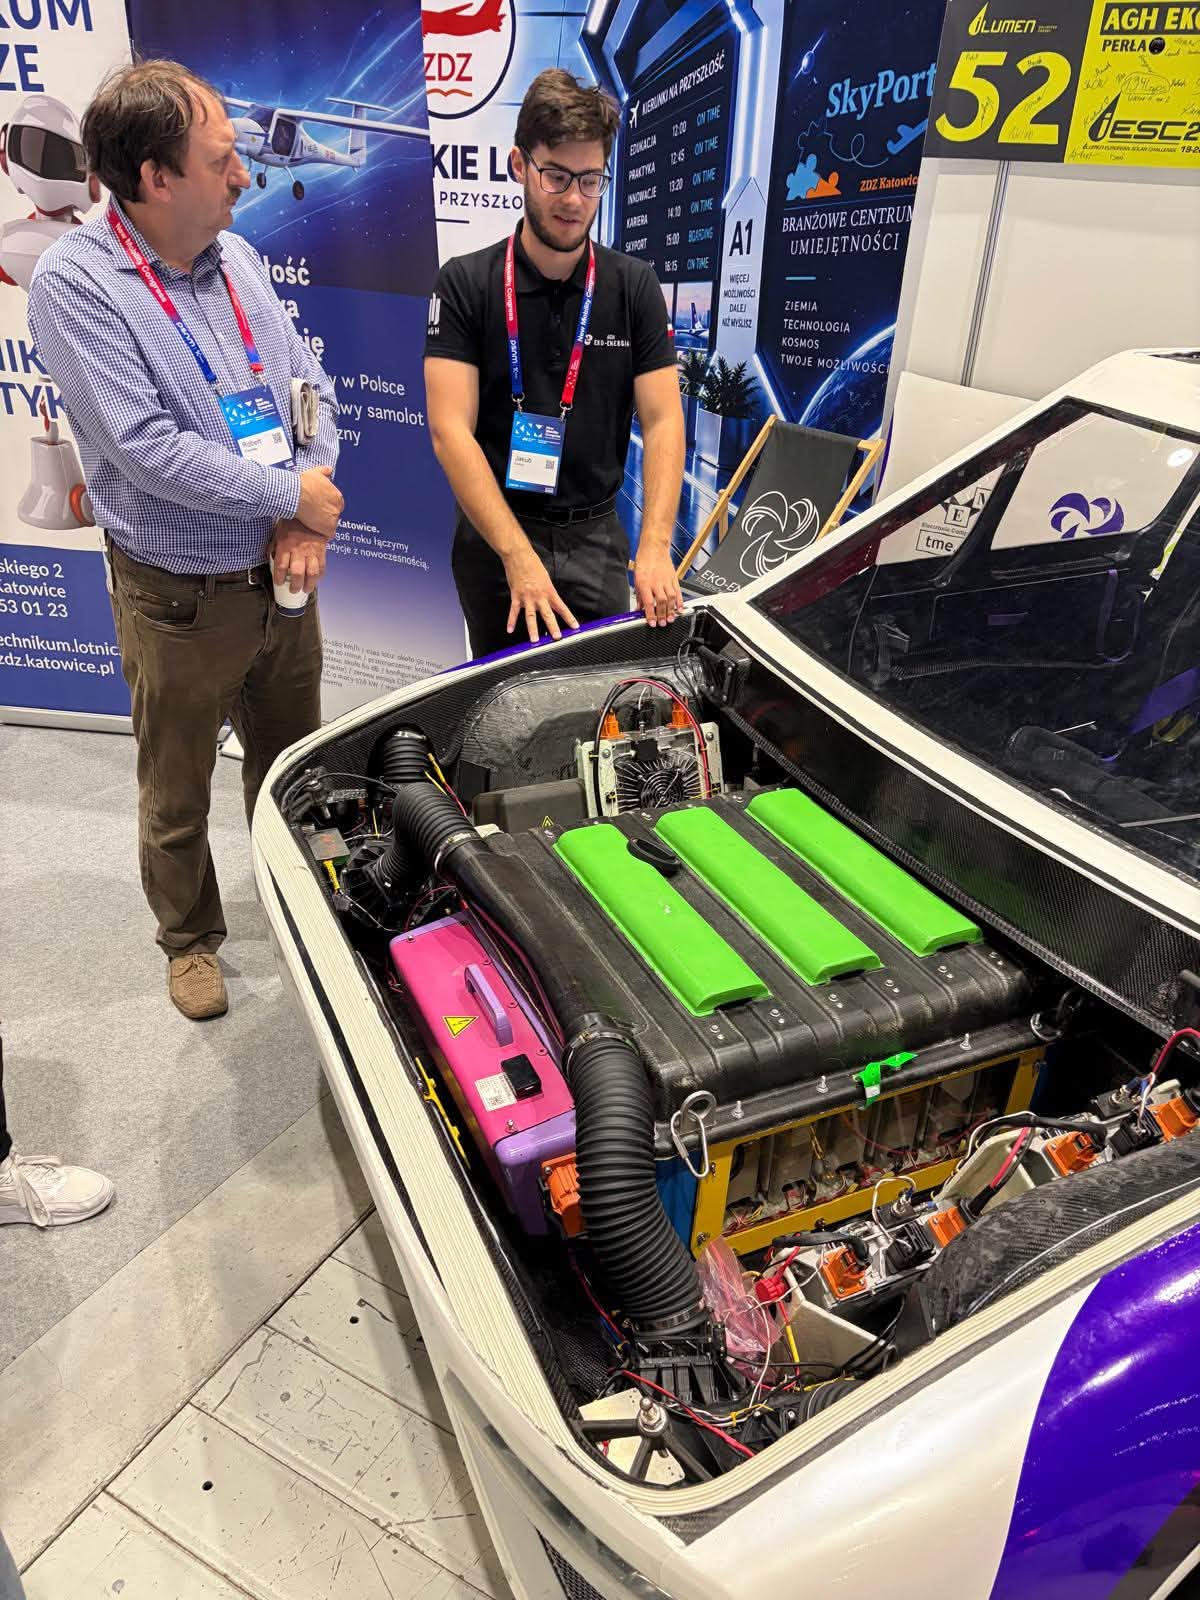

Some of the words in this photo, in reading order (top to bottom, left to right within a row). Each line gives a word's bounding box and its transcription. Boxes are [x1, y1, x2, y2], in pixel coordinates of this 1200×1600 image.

[0, 0, 93, 31] UM
[1103, 7, 1160, 31] AGH
[1101, 38, 1147, 52] PERŁA
[424, 53, 472, 82] ZDZ
[669, 84, 678, 100] NA
[679, 49, 725, 94] PRZYSZŁOŚĆ
[825, 63, 937, 120] SkyPort
[935, 51, 1072, 145] 52
[629, 134, 657, 156] EDUKACJA
[672, 121, 687, 137] 12:00
[696, 111, 706, 127] ON
[707, 105, 721, 121] TIME
[490, 146, 516, 183] L
[628, 161, 655, 181] PRAKTYKA
[670, 149, 685, 166] 12:45
[694, 142, 704, 156] ON
[705, 136, 719, 151] TIME
[627, 186, 657, 205] INNOWACJE
[669, 178, 684, 193] 13:20
[692, 173, 702, 186] ON
[702, 168, 716, 182] TIME
[860, 178, 879, 192] ZDZ
[626, 214, 649, 229] KARIERA
[667, 205, 681, 218] 14:10
[690, 202, 700, 214] ON
[700, 198, 713, 211] TIME
[783, 211, 847, 233] BRANŻOWE
[625, 238, 648, 253] SKYPORT
[666, 232, 680, 247] 15:00
[688, 227, 714, 243] BOARDING
[729, 218, 754, 257] A1
[790, 230, 900, 257] UMIEJĘTNOŚCI
[124, 236, 143, 266] Mobility
[141, 264, 168, 303] Congress
[687, 259, 697, 271] ON
[697, 257, 710, 270] TIME
[729, 273, 750, 285] WIĘCEJ
[723, 287, 756, 299] MOŻLIWOŚCI
[729, 303, 747, 314] DALEJ
[784, 300, 818, 312] ZIEMIA
[731, 317, 753, 329] MYŚLISZ
[784, 318, 850, 333] TECHNOLOGIA
[782, 337, 820, 349] KOSMOS
[781, 354, 813, 367] TWOJE
[341, 376, 355, 388] w
[359, 373, 405, 396] Polsce
[367, 406, 425, 426] samolot
[352, 535, 371, 545] roku
[374, 537, 409, 553] łączymy
[52, 563, 65, 578] 2
[22, 601, 43, 616] 01
[48, 603, 68, 618] 23
